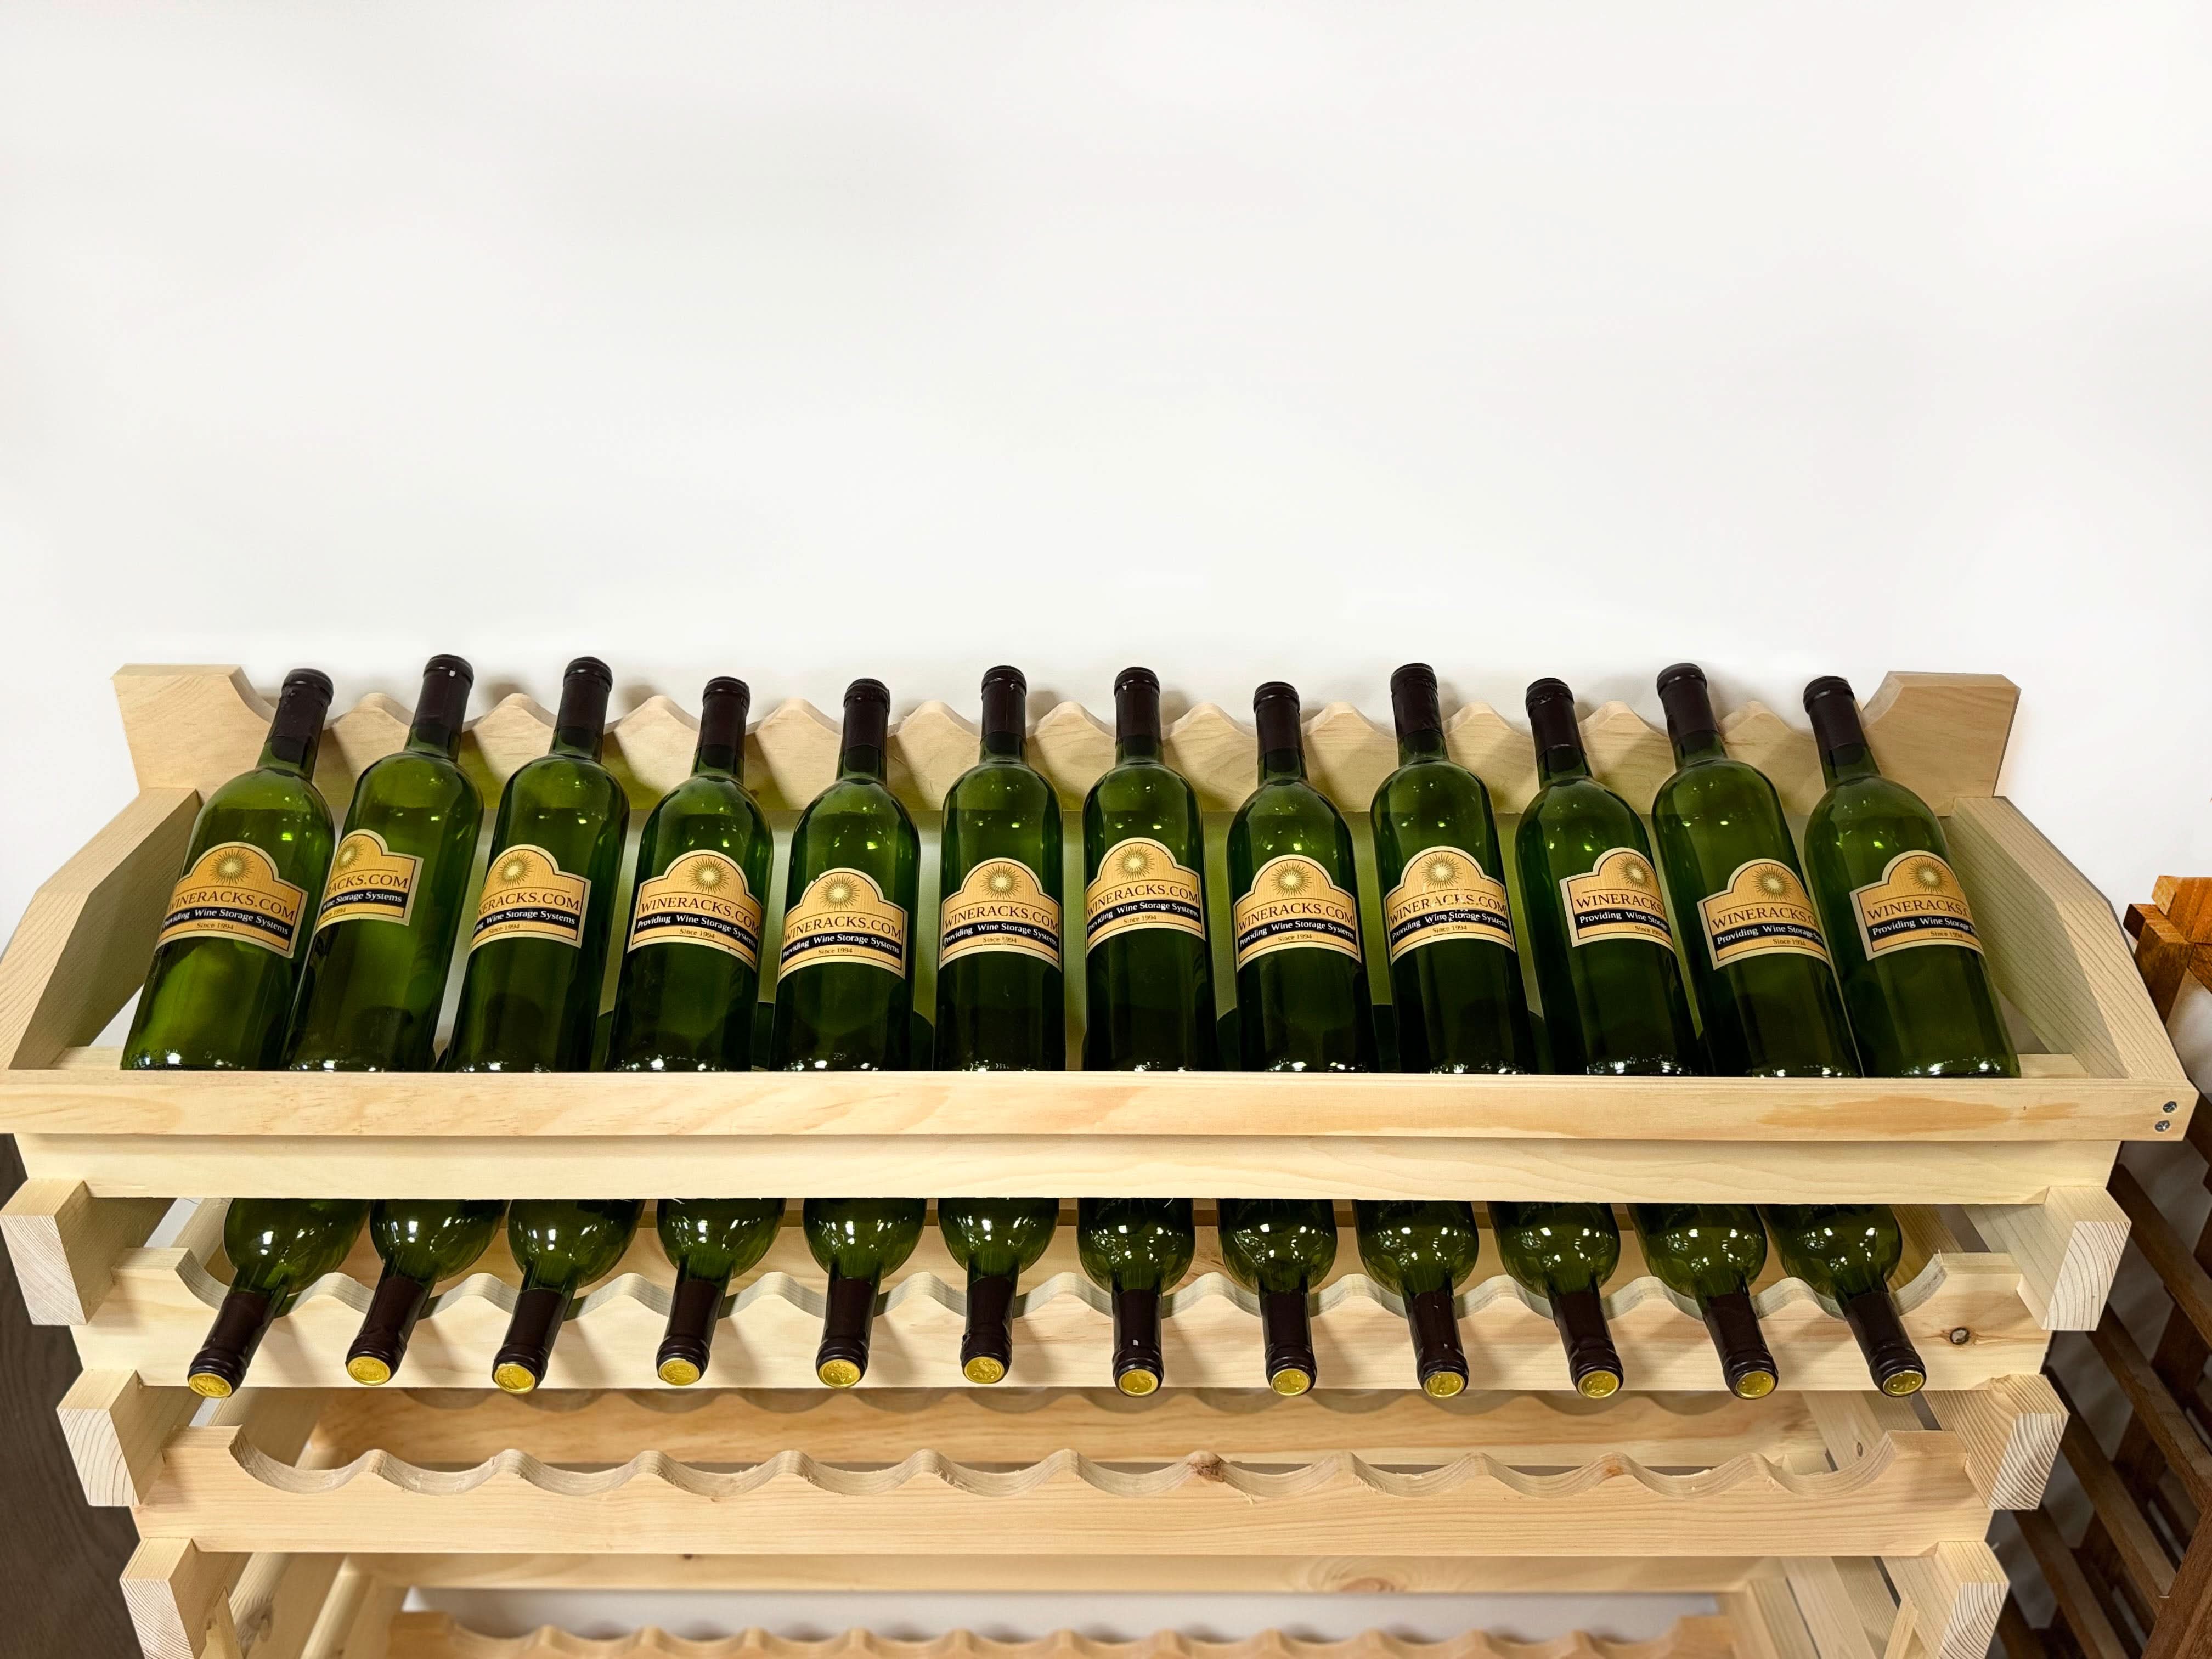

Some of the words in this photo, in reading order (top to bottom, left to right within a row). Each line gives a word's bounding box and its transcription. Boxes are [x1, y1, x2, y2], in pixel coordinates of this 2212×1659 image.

[169, 891, 295, 921] WINERACKS.COM
[336, 890, 363, 902] Storage
[366, 891, 402, 902] Systems
[1088, 884, 1198, 917] WINERACKS.COM
[195, 909, 217, 917] Wine
[219, 909, 253, 921] Storage
[256, 916, 288, 934] Systems
[486, 914, 504, 924] Wine
[540, 911, 575, 924] Systems
[642, 897, 759, 935] WINERACKS.COM
[945, 906, 1058, 934] WINERACKS.COM
[1088, 911, 1113, 933] Providing
[1116, 904, 1137, 913] Wine
[1140, 902, 1170, 911] Storage
[1172, 904, 1198, 917] Systems
[1239, 903, 1353, 931] WINERACKS.COM
[1390, 894, 1506, 925] WINERACKS.COM
[1579, 911, 1622, 923] Providing
[1626, 912, 1646, 921] Wine
[637, 916, 671, 928] Providing
[676, 915, 698, 923] Wine
[701, 917, 731, 932] Storage
[785, 916, 901, 944] WINERACKS.COM
[944, 927, 973, 945] Providing
[1001, 923, 1031, 934] Storage
[1033, 929, 1057, 946] Systems
[1240, 927, 1267, 946] Providing
[1271, 923, 1293, 932] Wine
[1295, 921, 1325, 929] Storage
[1328, 924, 1354, 939] Systems
[1392, 919, 1421, 940] Providing
[1449, 912, 1481, 921] Storage
[1717, 927, 1759, 944] Providing
[1787, 926, 1813, 938] Storage
[1872, 919, 1916, 936] Providing
[783, 940, 809, 957] Providing
[814, 935, 834, 944] Wine
[837, 934, 868, 944] Storage
[871, 938, 899, 953] Systems
